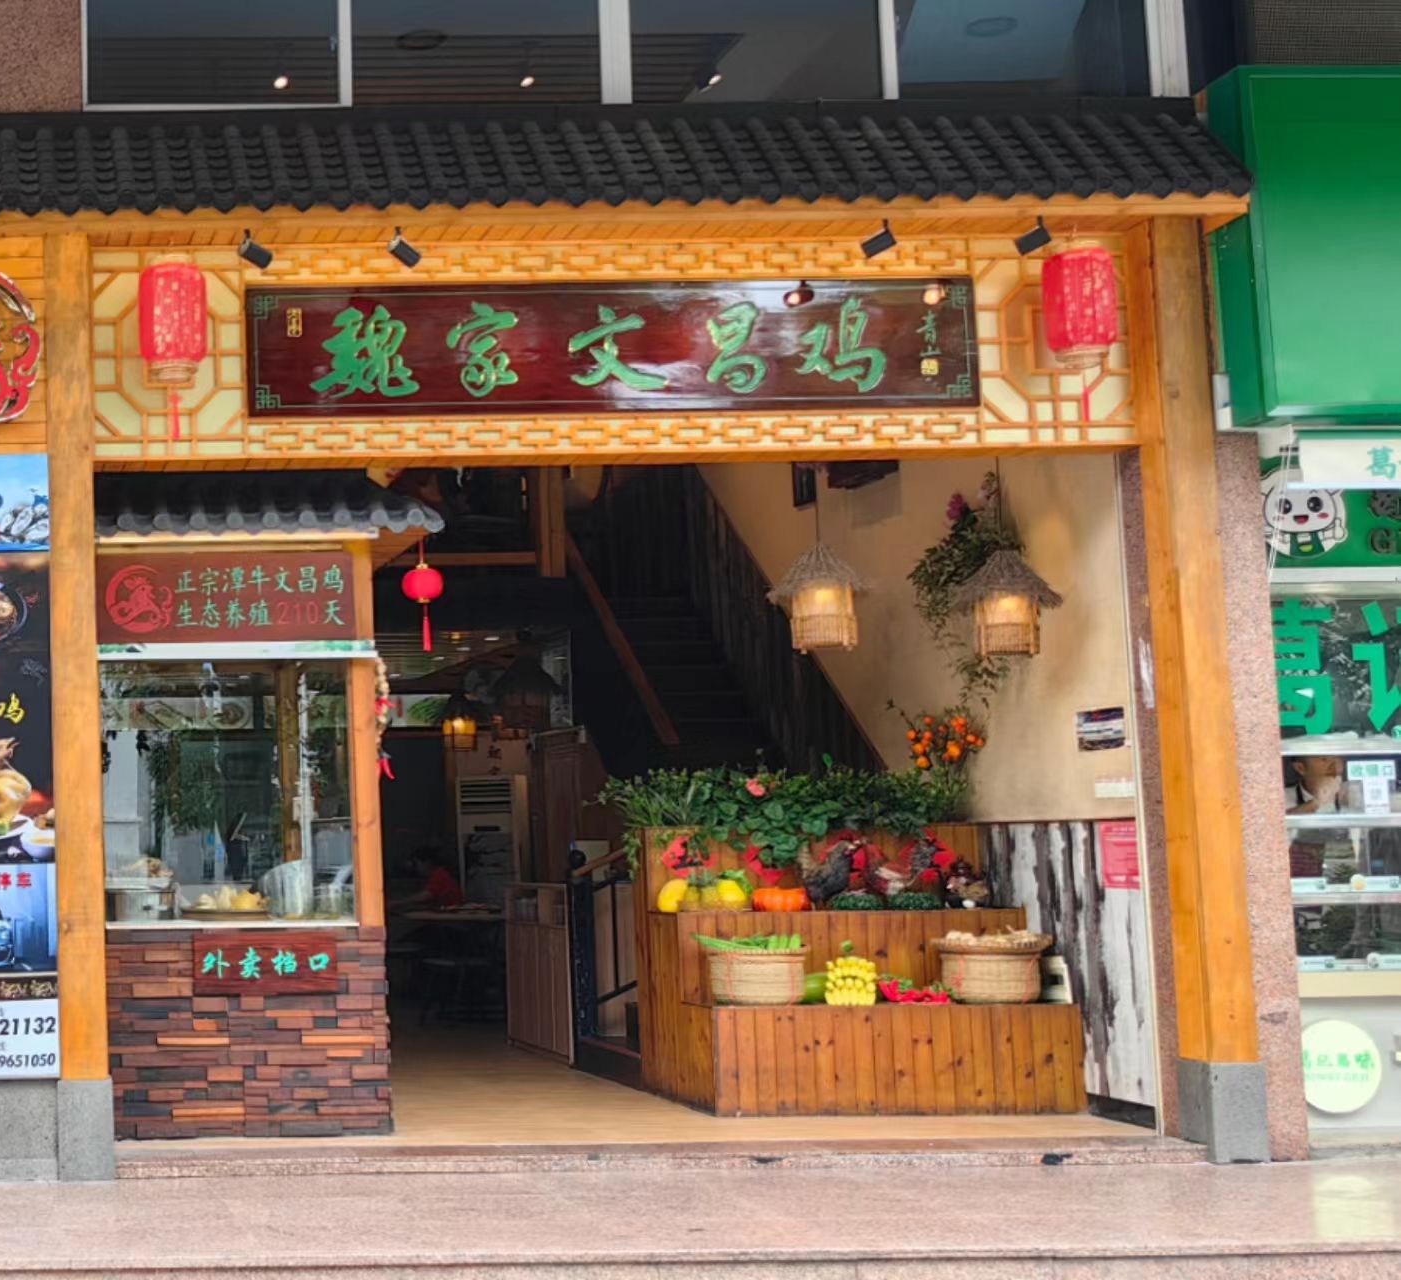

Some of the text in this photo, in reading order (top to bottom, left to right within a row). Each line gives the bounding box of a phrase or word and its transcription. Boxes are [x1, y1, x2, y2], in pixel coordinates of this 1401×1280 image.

[309, 298, 886, 398] 魏家文昌鸡
[175, 564, 344, 596] 正宗潭牛文昌鸡
[201, 946, 330, 979] 外卖档口
